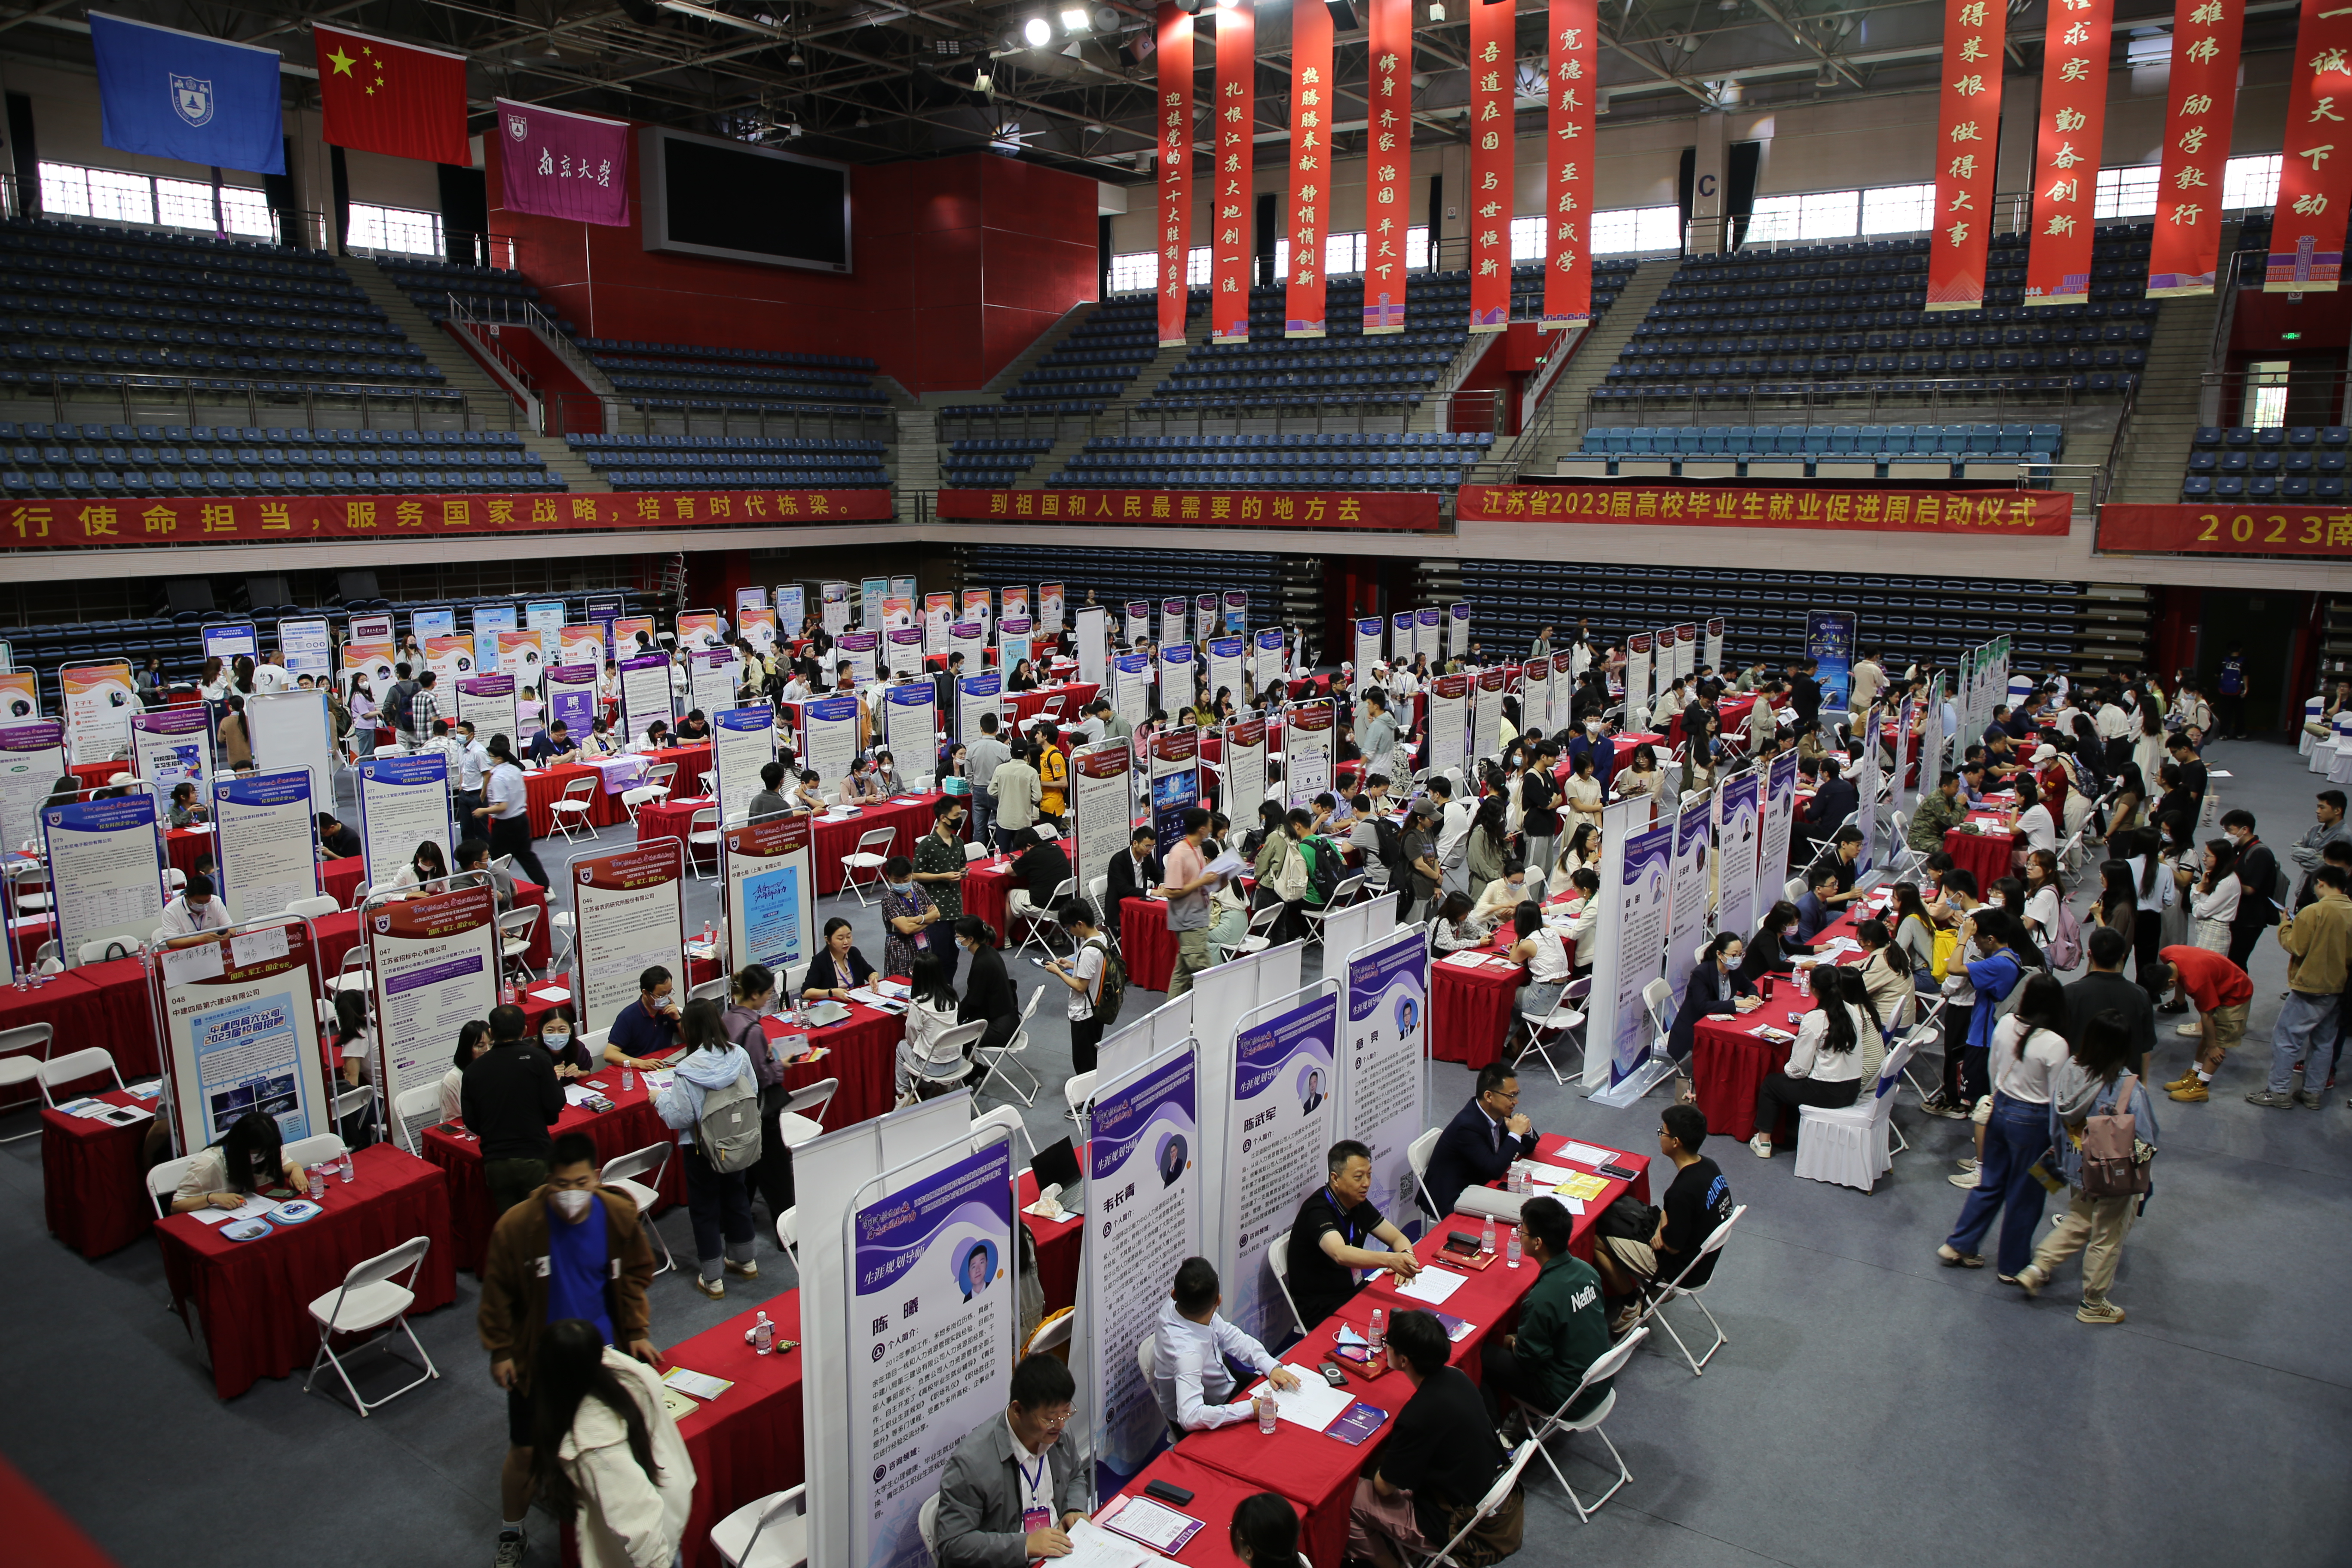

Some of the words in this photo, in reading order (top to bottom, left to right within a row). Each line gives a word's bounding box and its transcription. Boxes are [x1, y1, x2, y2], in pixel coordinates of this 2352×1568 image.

[1953, 3, 1990, 98] 得菜根
[1479, 40, 1503, 150] 吾道在国
[1556, 28, 1583, 139] 宽德养士
[174, 95, 190, 119] NANJING
[193, 101, 211, 124] UNIVERSITY
[2043, 106, 2086, 239] 勤奋创新
[2170, 93, 2213, 226] 励学敦行
[1165, 92, 1183, 299] 迎接党的二十大胜利召开
[1221, 82, 1243, 293] 扎根江苏大地创一流
[1698, 175, 1716, 197] C
[1946, 121, 1982, 248] 做得大事
[1477, 172, 1501, 278] 与世恒新
[1555, 162, 1579, 273] 至乐成学
[12, 494, 848, 538] 行使命担当，服务国家战略，培育时代栋梁。
[991, 493, 1362, 521] 到祖国和人民最需要的地方去
[1482, 489, 2037, 527] 江苏省2023届高校毕业生就业促进周启动仪式
[2197, 514, 2352, 546] 2023南
[567, 695, 579, 709] 聘
[732, 861, 782, 878] 中建七局（上海）有限公司
[583, 893, 655, 914] 江苏省农药研究所股份有限公司
[228, 962, 293, 980] 「国防、军工、国企专区」
[381, 944, 447, 966] 江苏省招标中心有限公司
[172, 996, 186, 1004] 048
[172, 988, 260, 1017] 中建四局第六建设有限公司
[204, 1016, 285, 1046] 2023届校园招聘
[210, 1008, 281, 1034] 中建四局六公司
[1243, 1106, 1277, 1133] 陈武军
[1253, 1130, 1274, 1145] 个人简介：
[1097, 1136, 1139, 1173] 生涯规划导师
[1103, 1182, 1135, 1213] 韦长青
[1113, 1209, 1134, 1228] 个人简介：
[863, 1243, 925, 1286] 生涯规划导师
[872, 1312, 995, 1388] 余年项目一线和人力资源管理实践经验，目前为
[885, 1301, 994, 1368] 2012年参加工作，多地多岗位历练，具备十
[887, 1327, 919, 1350] 个人简介：
[872, 1323, 995, 1400] 中建八局第三建设有限公司人力资源部经理、干
[872, 1335, 995, 1413] 部人事部部长，负责公司人力资源管理全面工
[873, 1346, 995, 1425] 作，自主开发了《高校毕业生就业辅导》《青年
[873, 1358, 995, 1437] 员工职业生涯规划》《职场礼仪》《职场胜任力
[873, 1370, 995, 1449] 提升》等多门课程，受邀为多所高校、企事业单
[873, 1425, 929, 1461] 位进行经验交流分享。
[888, 1447, 920, 1471] 咨询领域：
[874, 1510, 884, 1520] 容。
